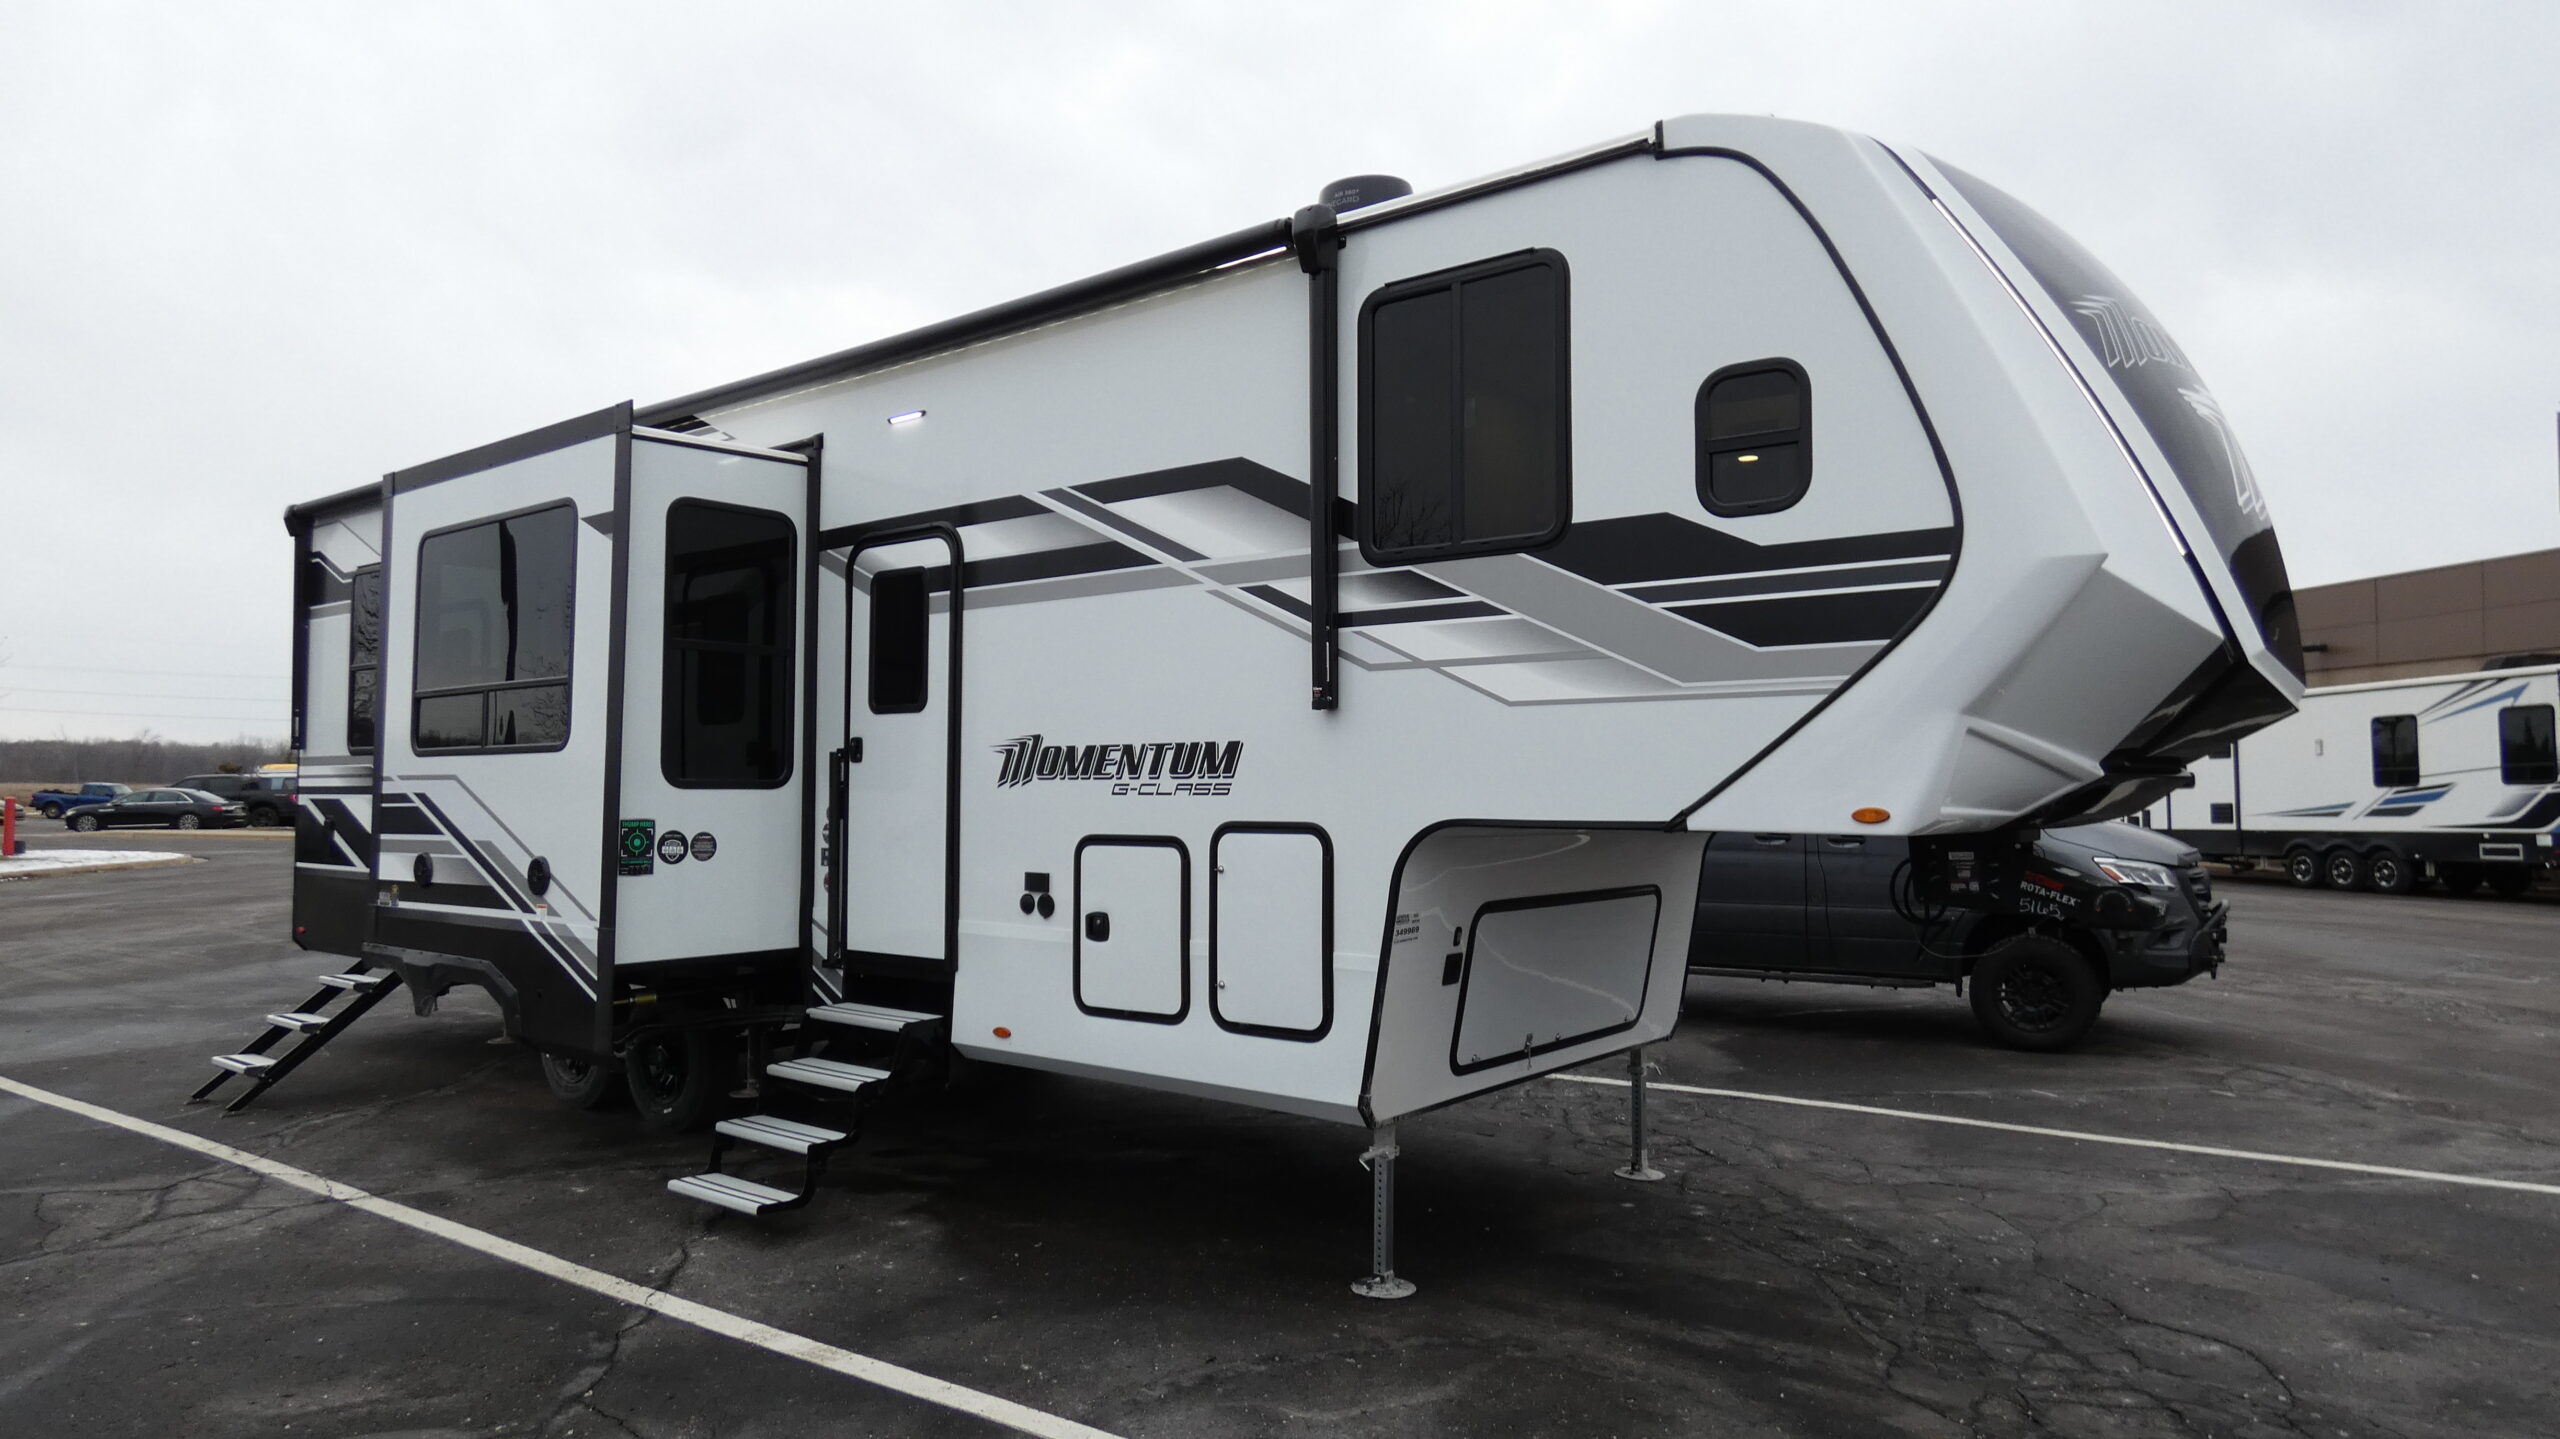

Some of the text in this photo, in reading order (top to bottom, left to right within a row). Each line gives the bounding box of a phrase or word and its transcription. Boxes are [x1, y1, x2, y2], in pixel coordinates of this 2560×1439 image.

[989, 733, 1244, 789] MOMENTUM
[1111, 782, 1233, 797] G-CLASS
[2020, 880, 2077, 907] ROTA-FLEX
